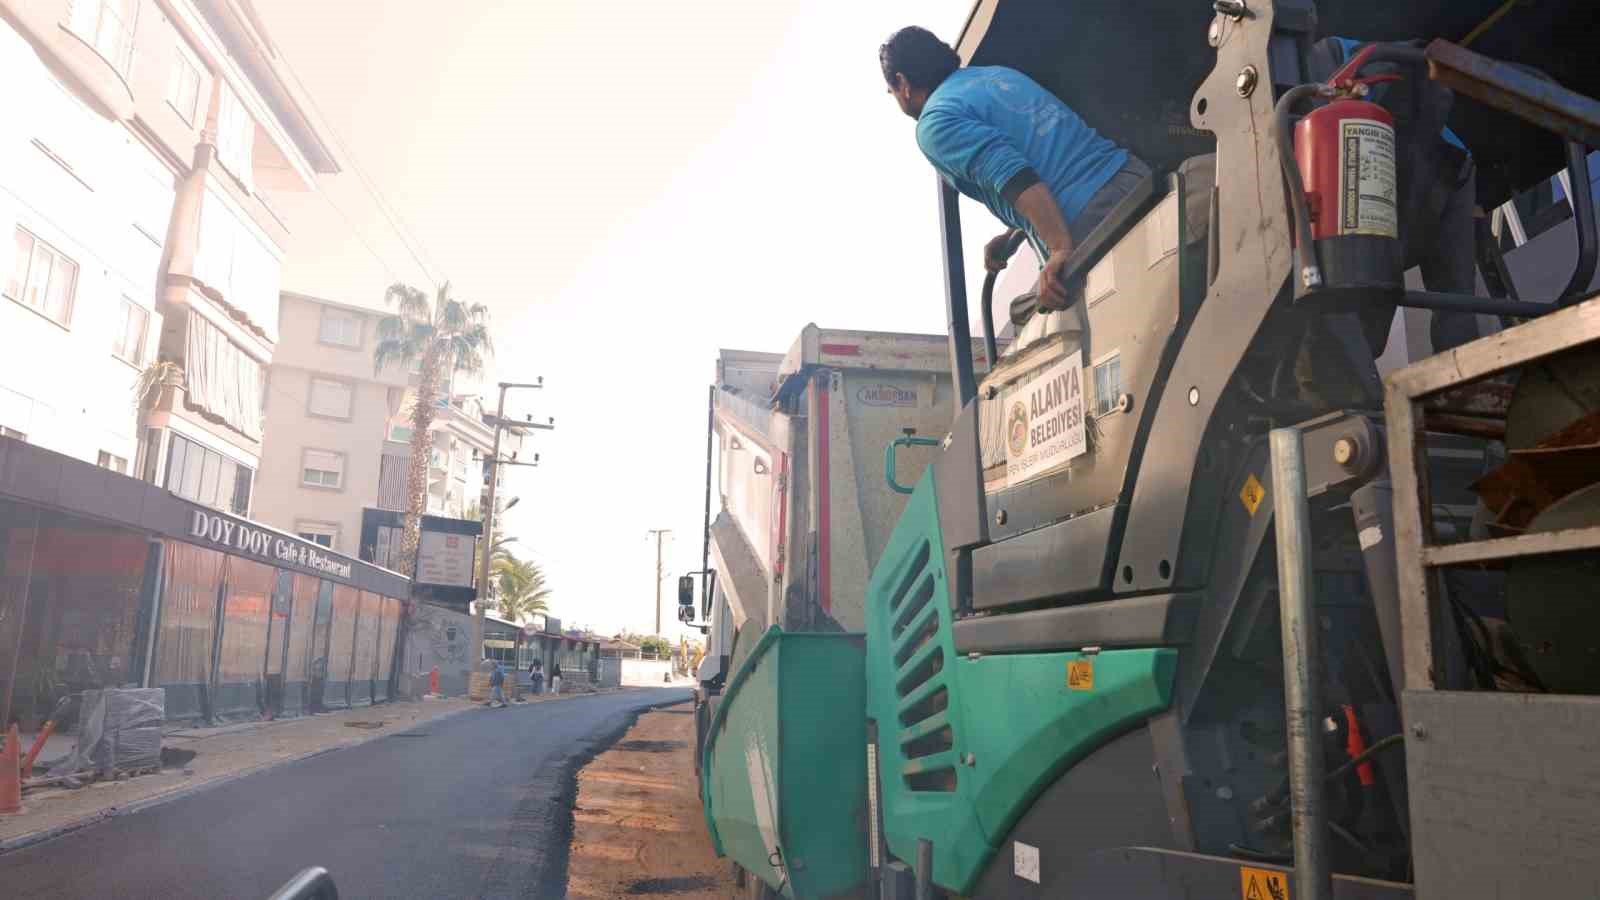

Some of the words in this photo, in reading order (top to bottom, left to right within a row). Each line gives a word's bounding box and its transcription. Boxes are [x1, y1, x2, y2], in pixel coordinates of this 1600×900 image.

[1031, 366, 1080, 422] ALANYA
[191, 510, 235, 546] DOY
[237, 525, 273, 557] DOY
[299, 545, 307, 566] &
[308, 548, 352, 579] Restaurant
